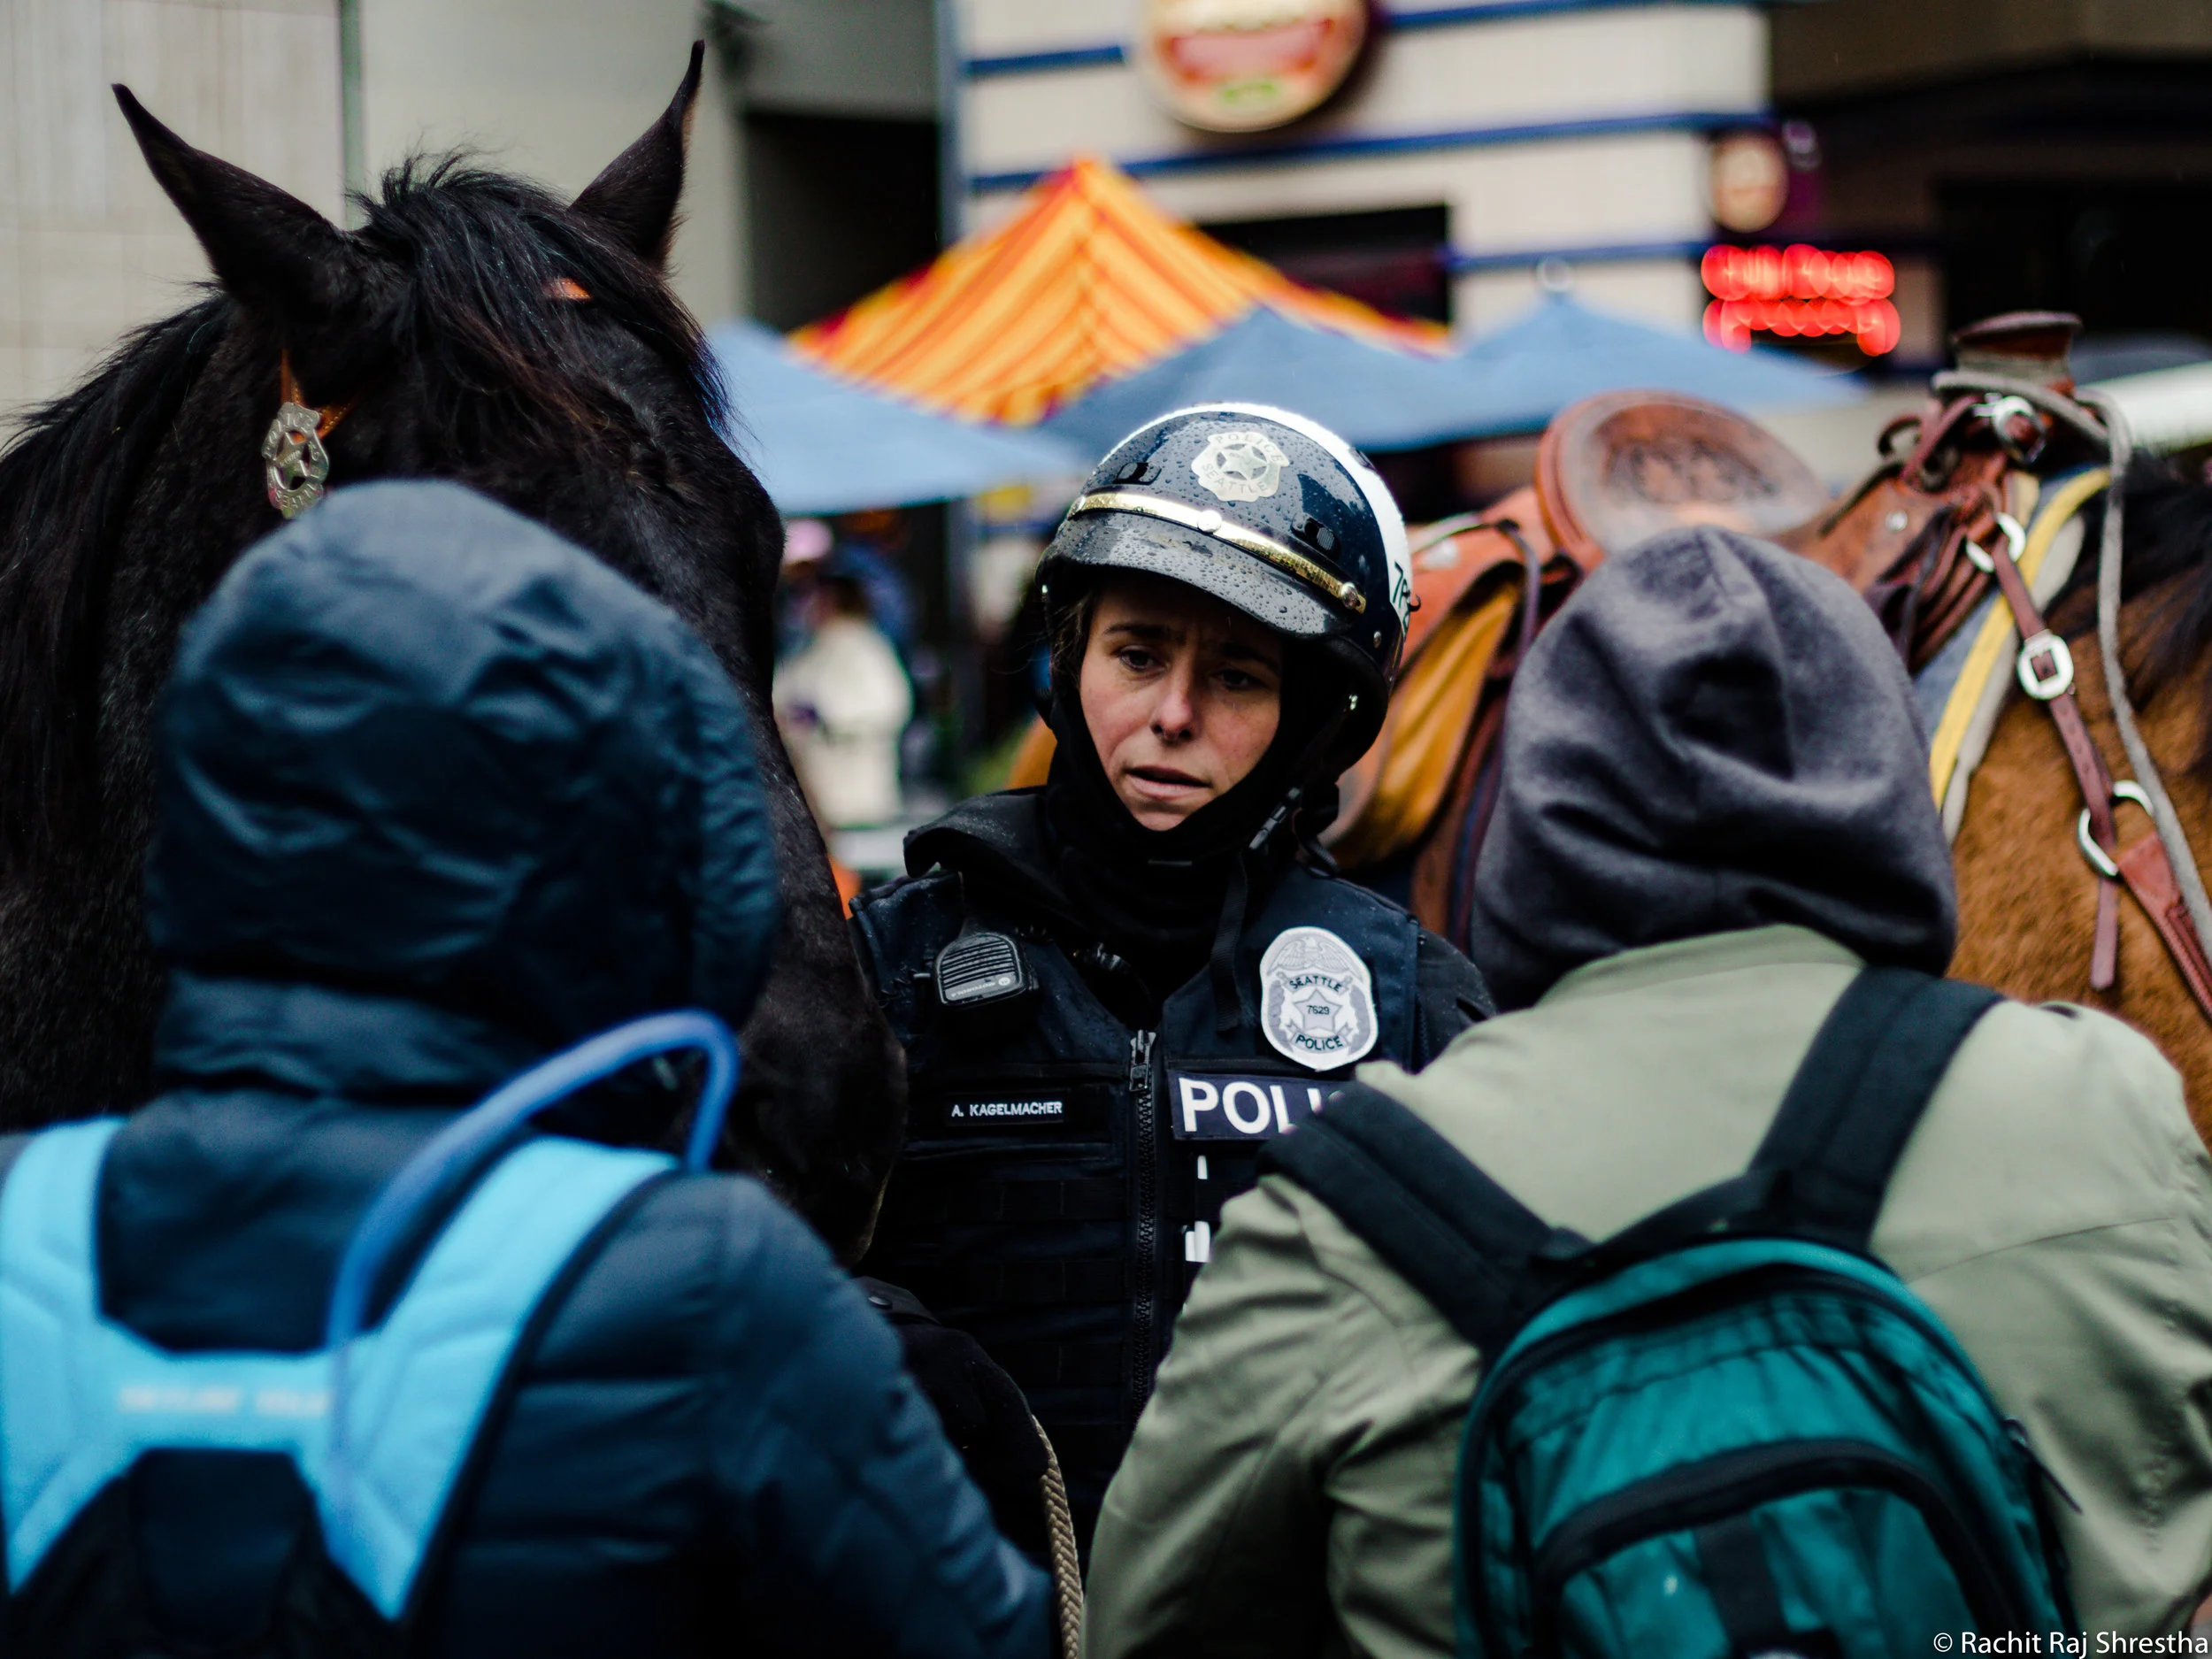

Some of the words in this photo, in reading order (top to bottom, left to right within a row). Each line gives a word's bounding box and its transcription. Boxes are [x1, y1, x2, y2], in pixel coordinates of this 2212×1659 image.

[1215, 433, 1282, 461] POLICE
[1202, 463, 1268, 495] SEATTLE
[1289, 976, 1343, 993] SEATTLE
[1306, 1004, 1330, 1016] 7629
[1294, 1034, 1345, 1051] POLICE
[951, 1104, 964, 1118] A.
[970, 1101, 1063, 1117] KAGELMACHER
[1179, 1077, 1345, 1135] POLI
